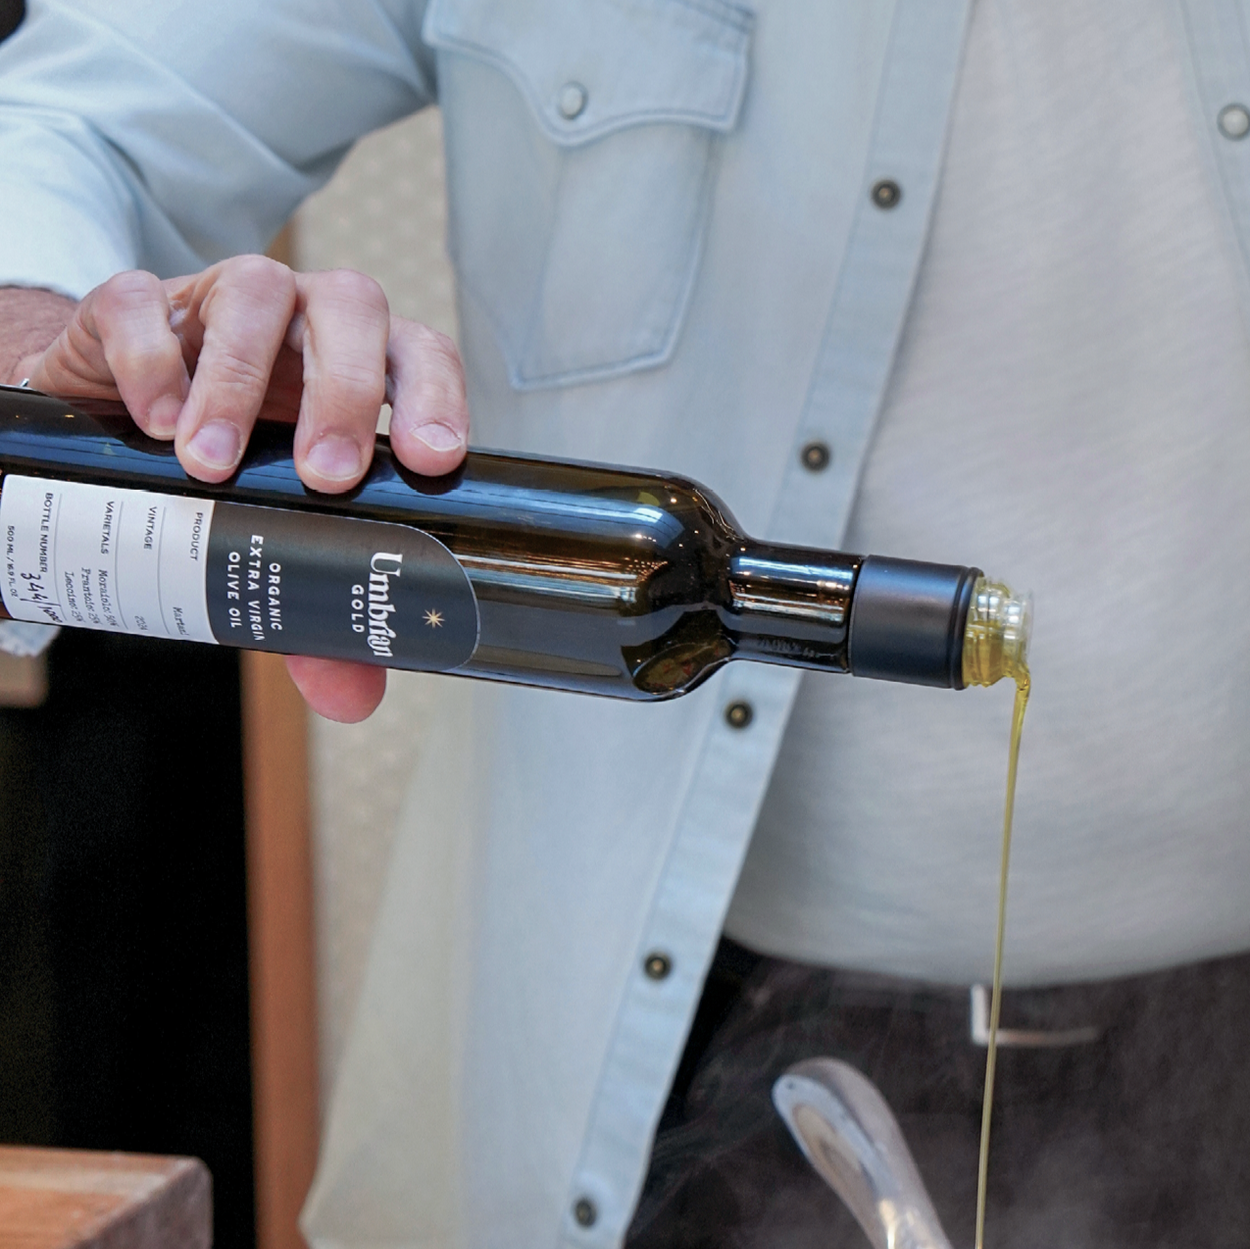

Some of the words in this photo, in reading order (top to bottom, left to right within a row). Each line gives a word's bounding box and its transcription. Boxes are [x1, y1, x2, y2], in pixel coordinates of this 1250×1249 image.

[6, 525, 15, 542] 500
[41, 492, 54, 531] BOTTLE
[100, 501, 115, 554] VARIETALS
[143, 506, 158, 549] VINTAGE
[6, 543, 14, 555] ML
[39, 534, 49, 573] NUMBER
[190, 512, 204, 561] PRODUCT
[227, 551, 241, 600] OLIVE
[247, 534, 264, 590] EXTRA
[228, 607, 242, 628] OIL
[268, 562, 282, 630] ORGANIC
[351, 584, 365, 633] GOLD
[367, 552, 403, 657] Umbrian
[247, 600, 265, 641] VIRGIN
